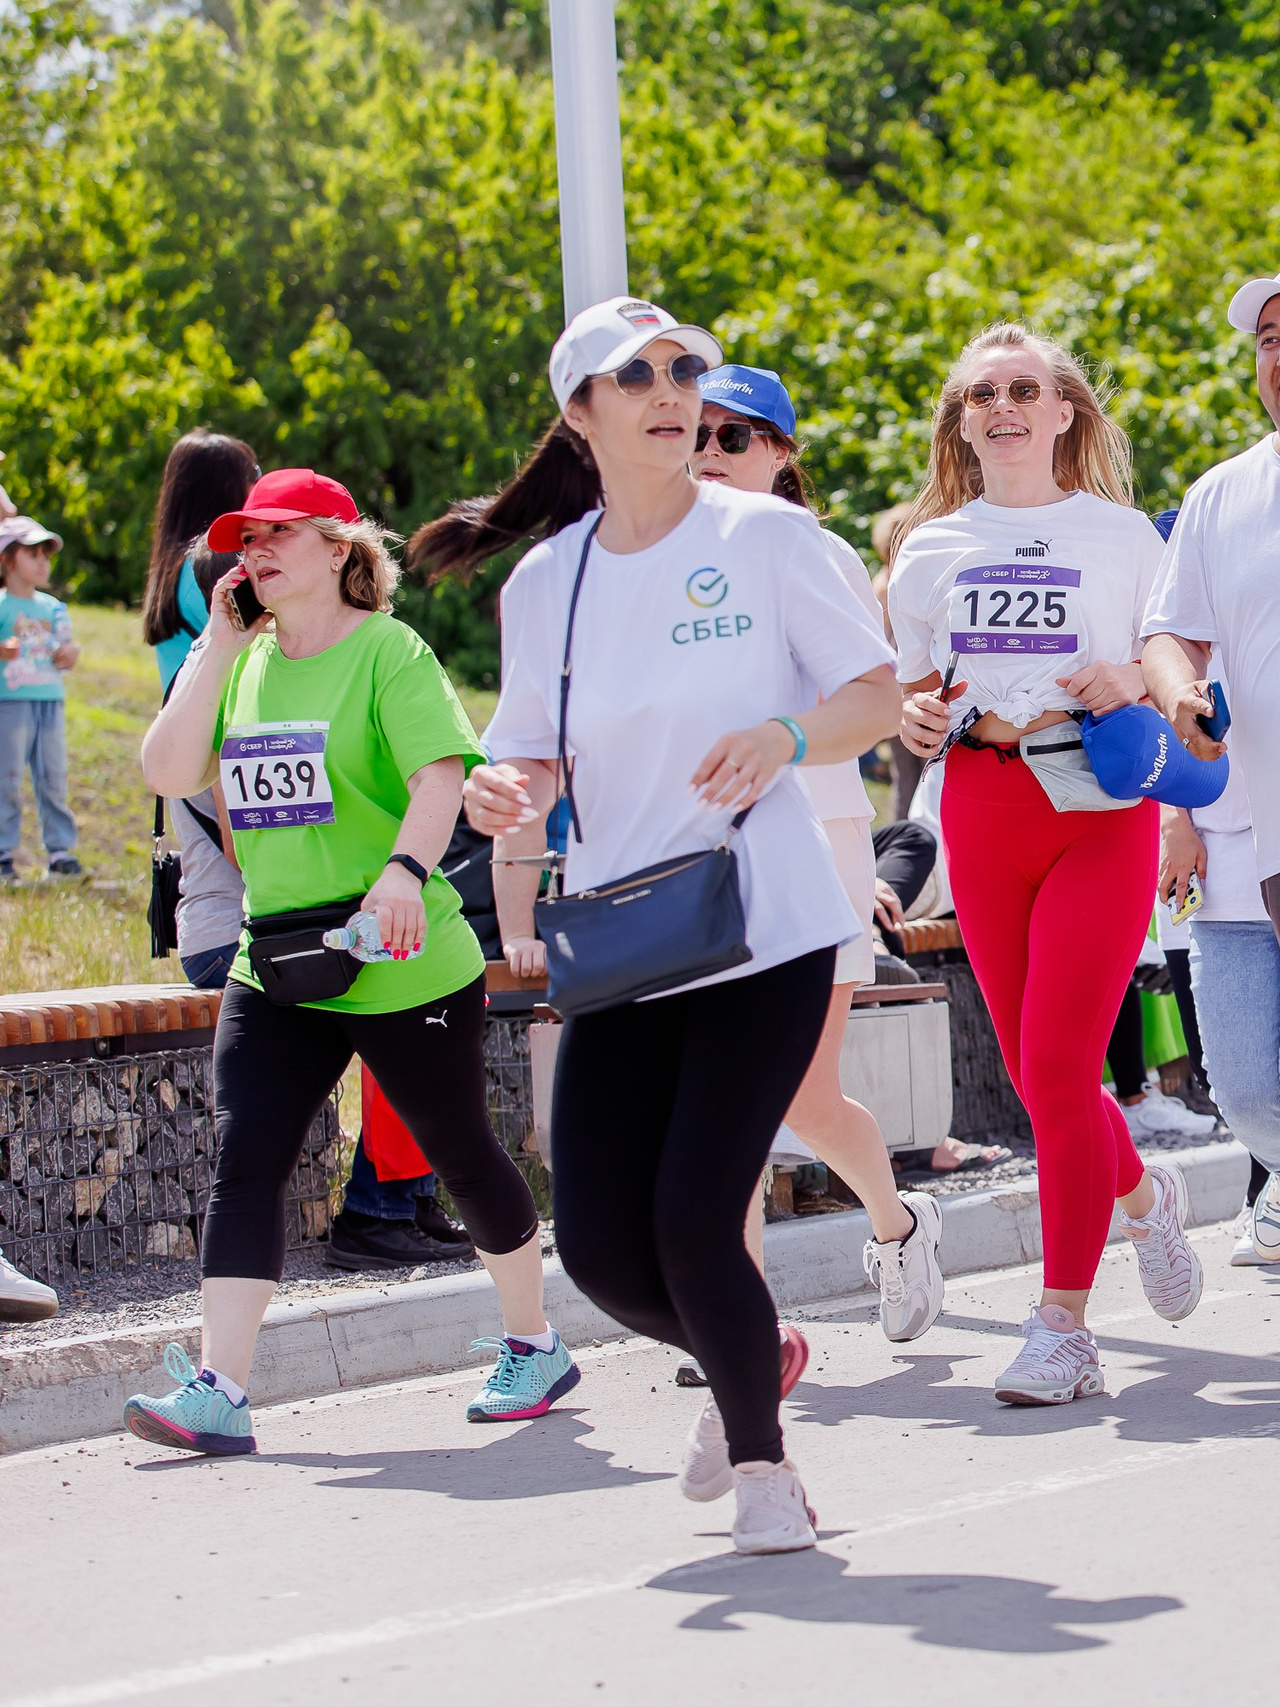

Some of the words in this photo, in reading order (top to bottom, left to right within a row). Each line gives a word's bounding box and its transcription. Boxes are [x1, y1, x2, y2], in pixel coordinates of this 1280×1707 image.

[1015, 547, 1045, 557] PUMA
[963, 590, 1066, 628] 1225
[672, 615, 752, 645] СБЕР
[231, 760, 315, 802] 1639
